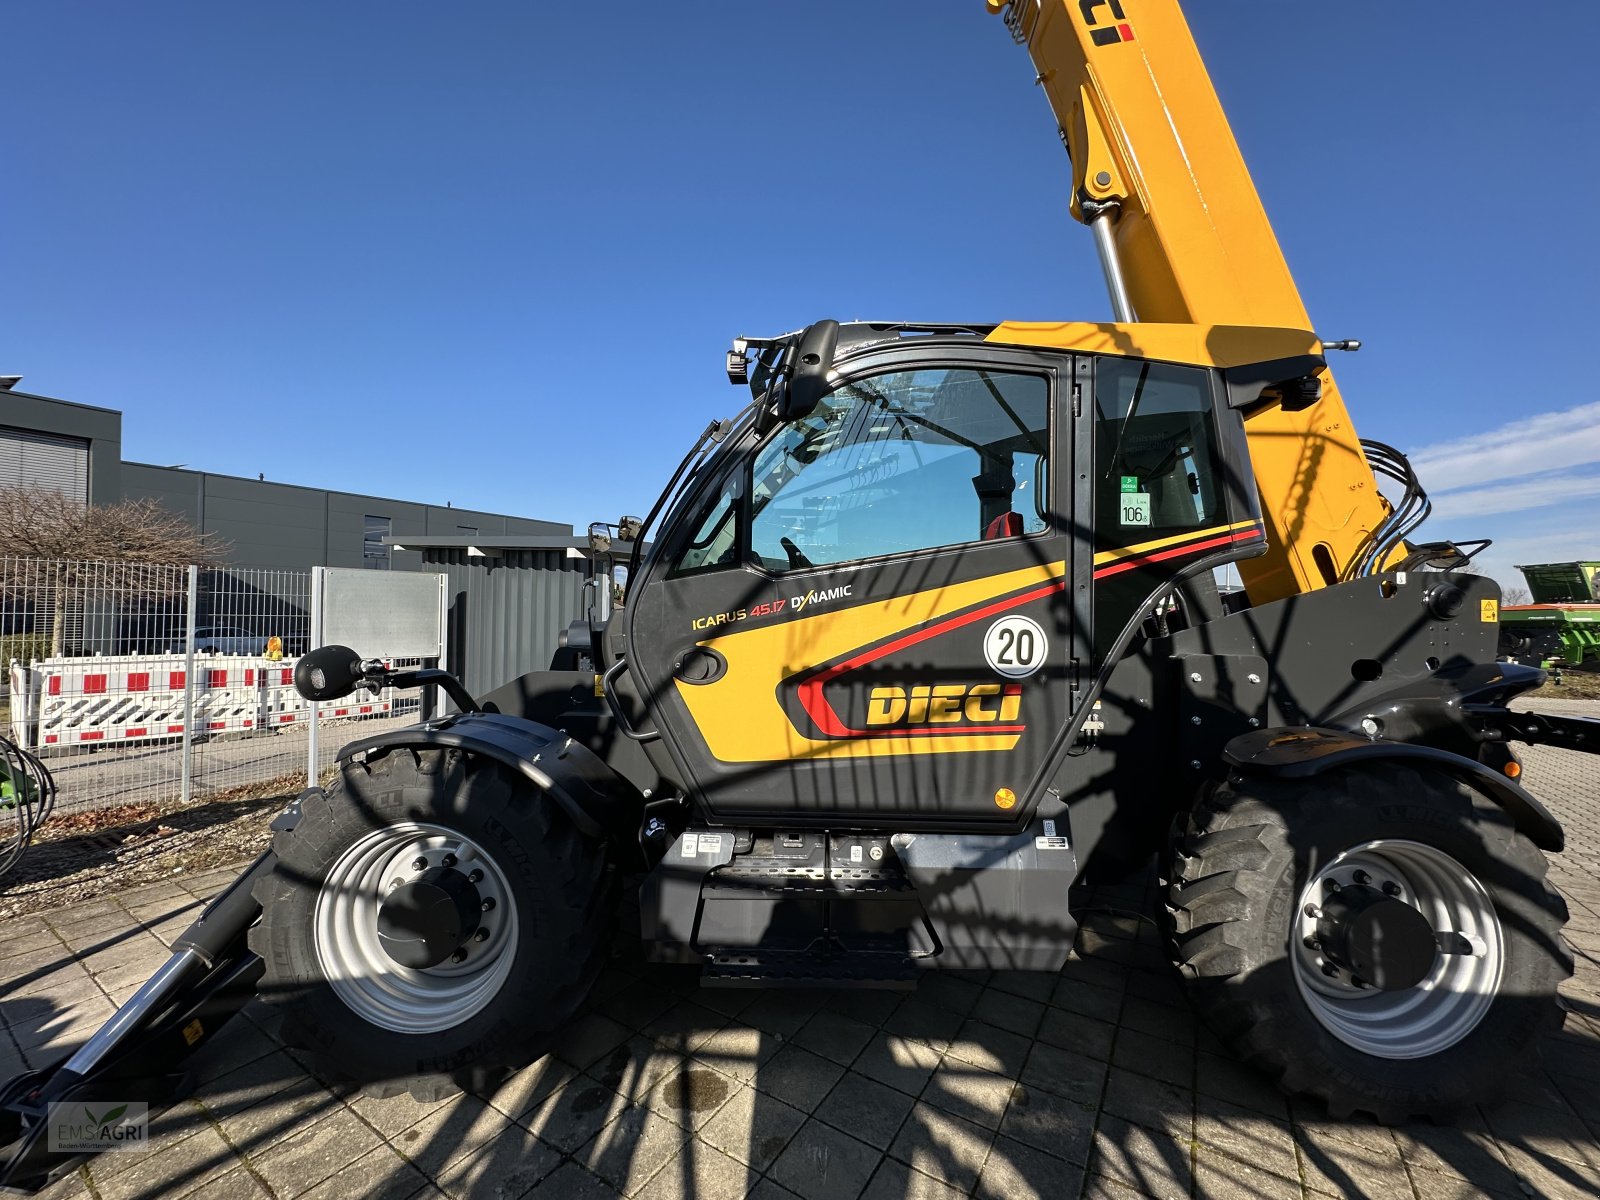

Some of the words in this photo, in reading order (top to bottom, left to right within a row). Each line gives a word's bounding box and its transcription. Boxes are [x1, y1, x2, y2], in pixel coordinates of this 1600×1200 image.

[1123, 506, 1142, 522] 106
[692, 608, 747, 631] ICARUS
[750, 600, 786, 617] 45.17
[791, 585, 852, 612] DYNAMIC
[997, 627, 1035, 666] 20
[866, 683, 1023, 725] DIECI
